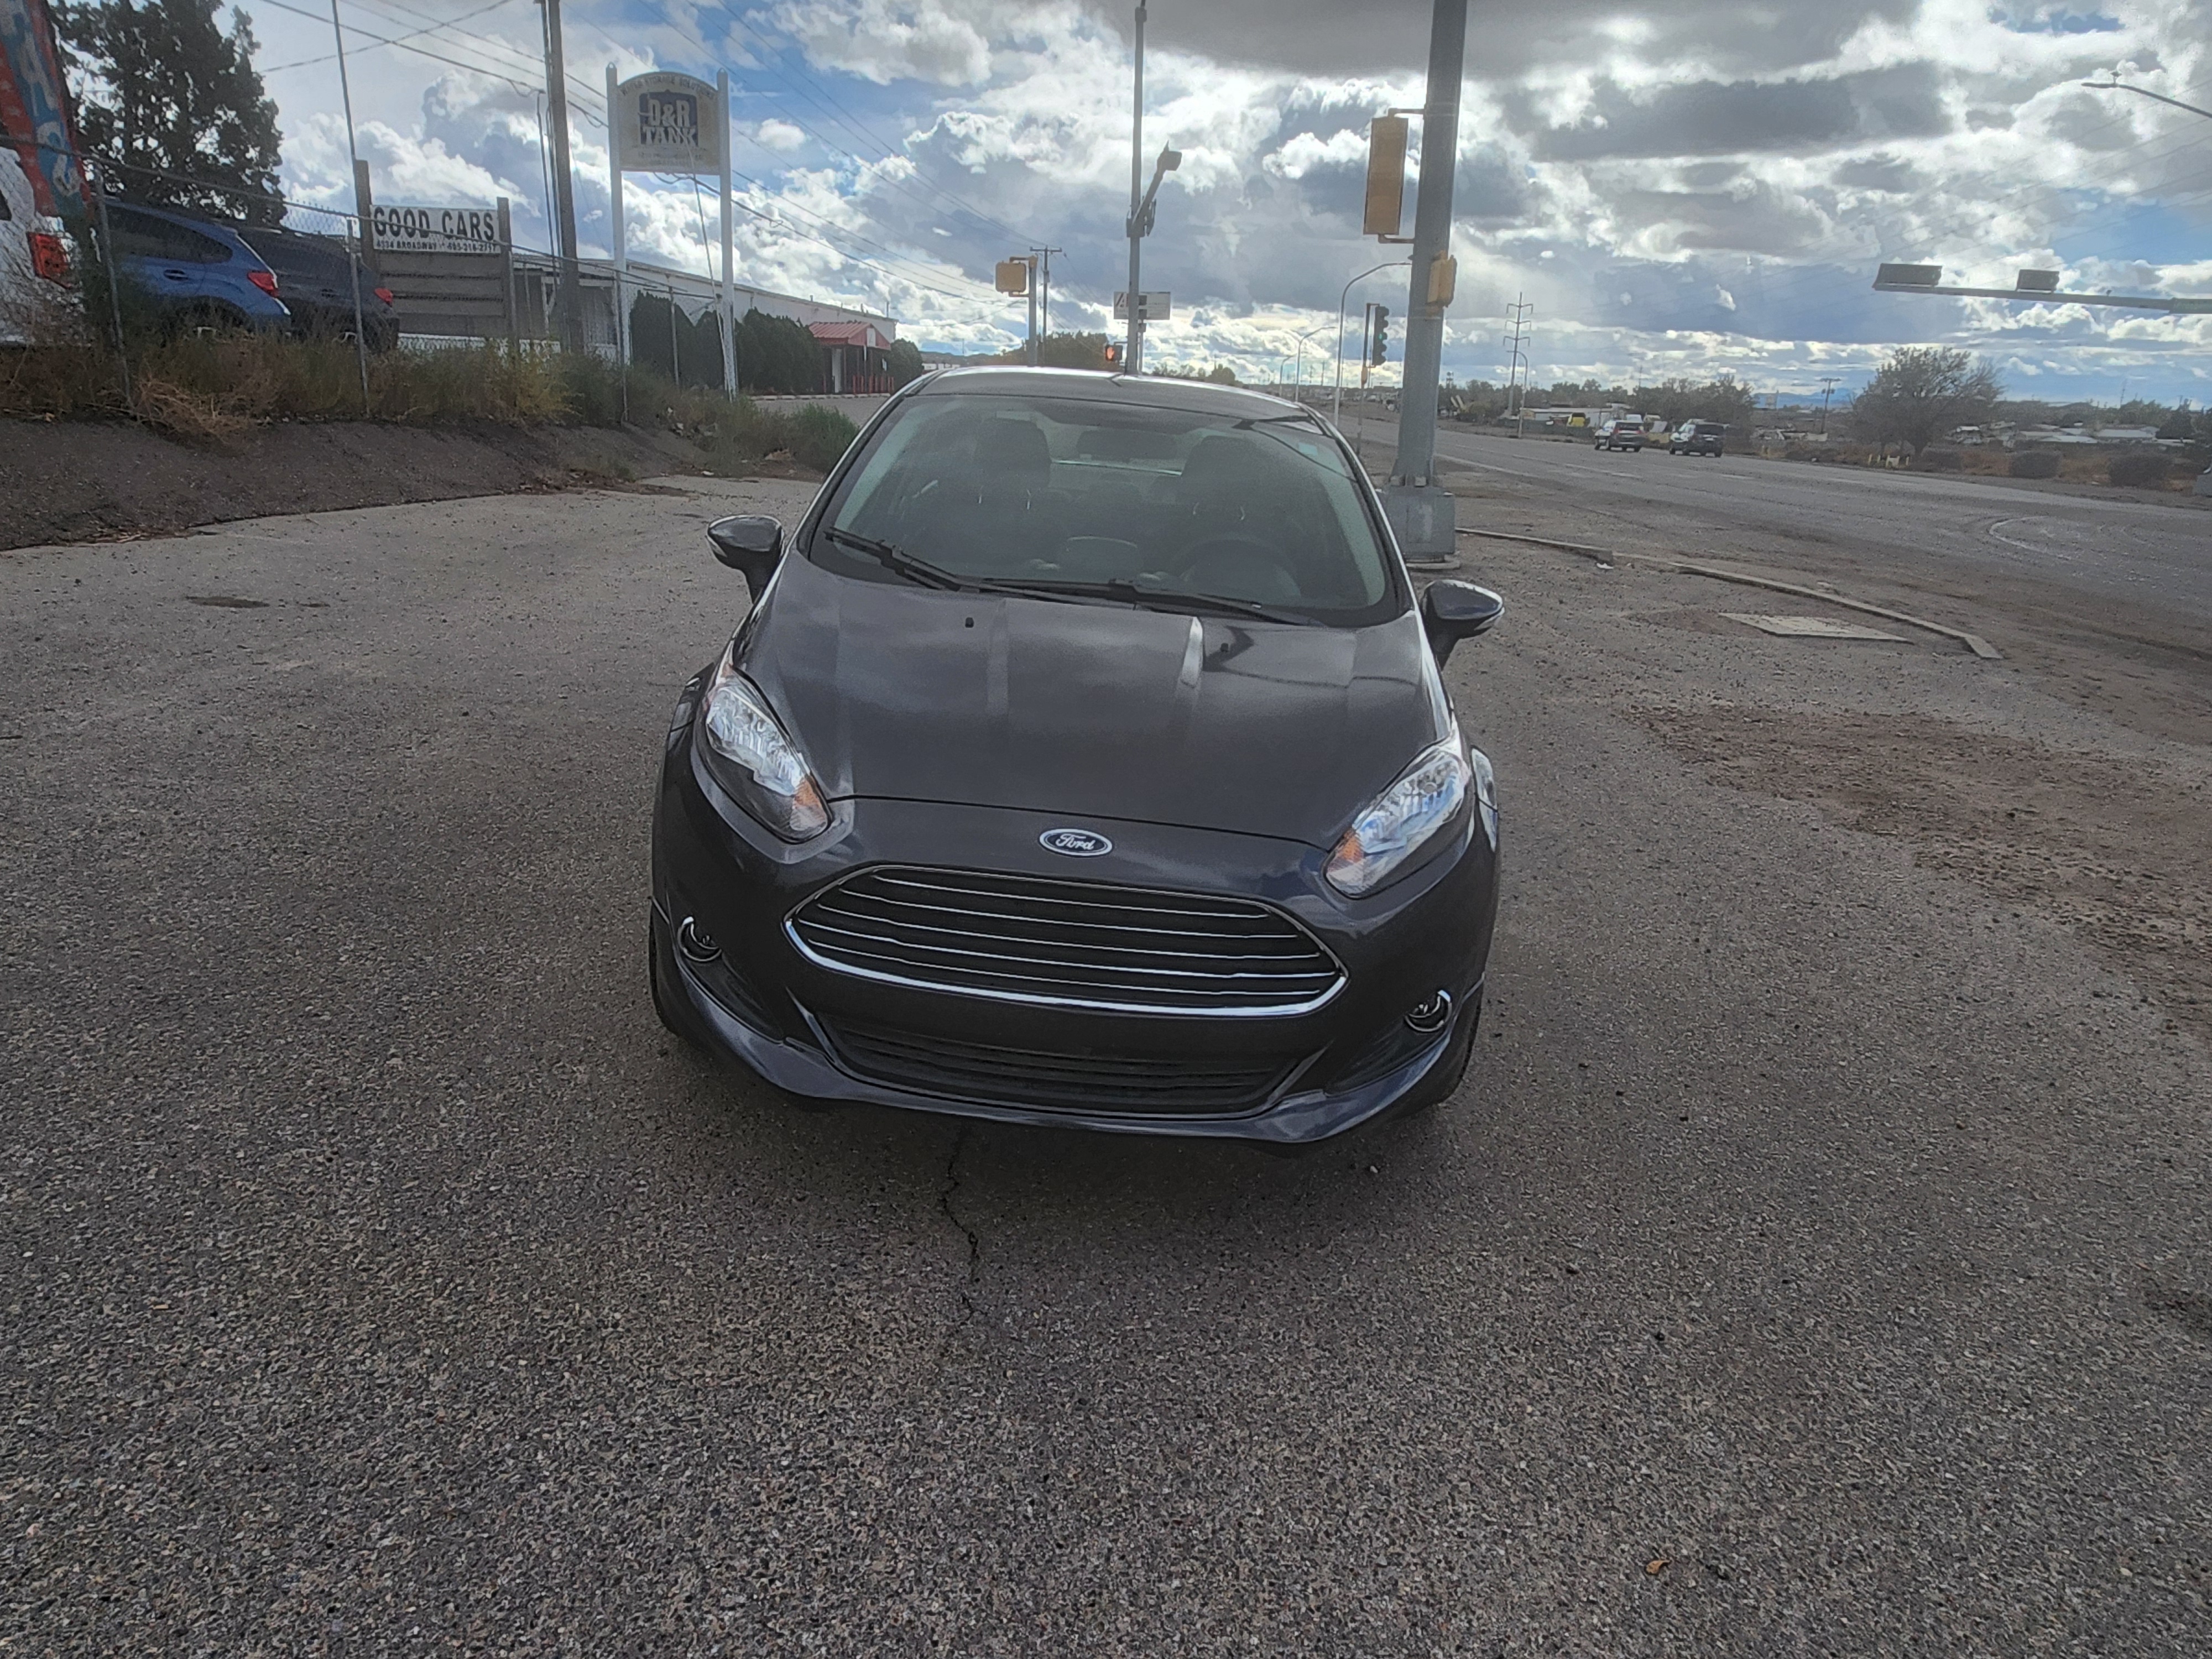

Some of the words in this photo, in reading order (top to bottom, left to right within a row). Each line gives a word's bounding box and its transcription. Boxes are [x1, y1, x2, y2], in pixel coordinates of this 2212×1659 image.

[648, 98, 691, 127] D&R
[642, 127, 697, 147] TANK
[373, 206, 431, 238] GOOD
[442, 210, 495, 241] CARS
[397, 240, 436, 251] BROADWAY
[1055, 833, 1096, 850] Ford
